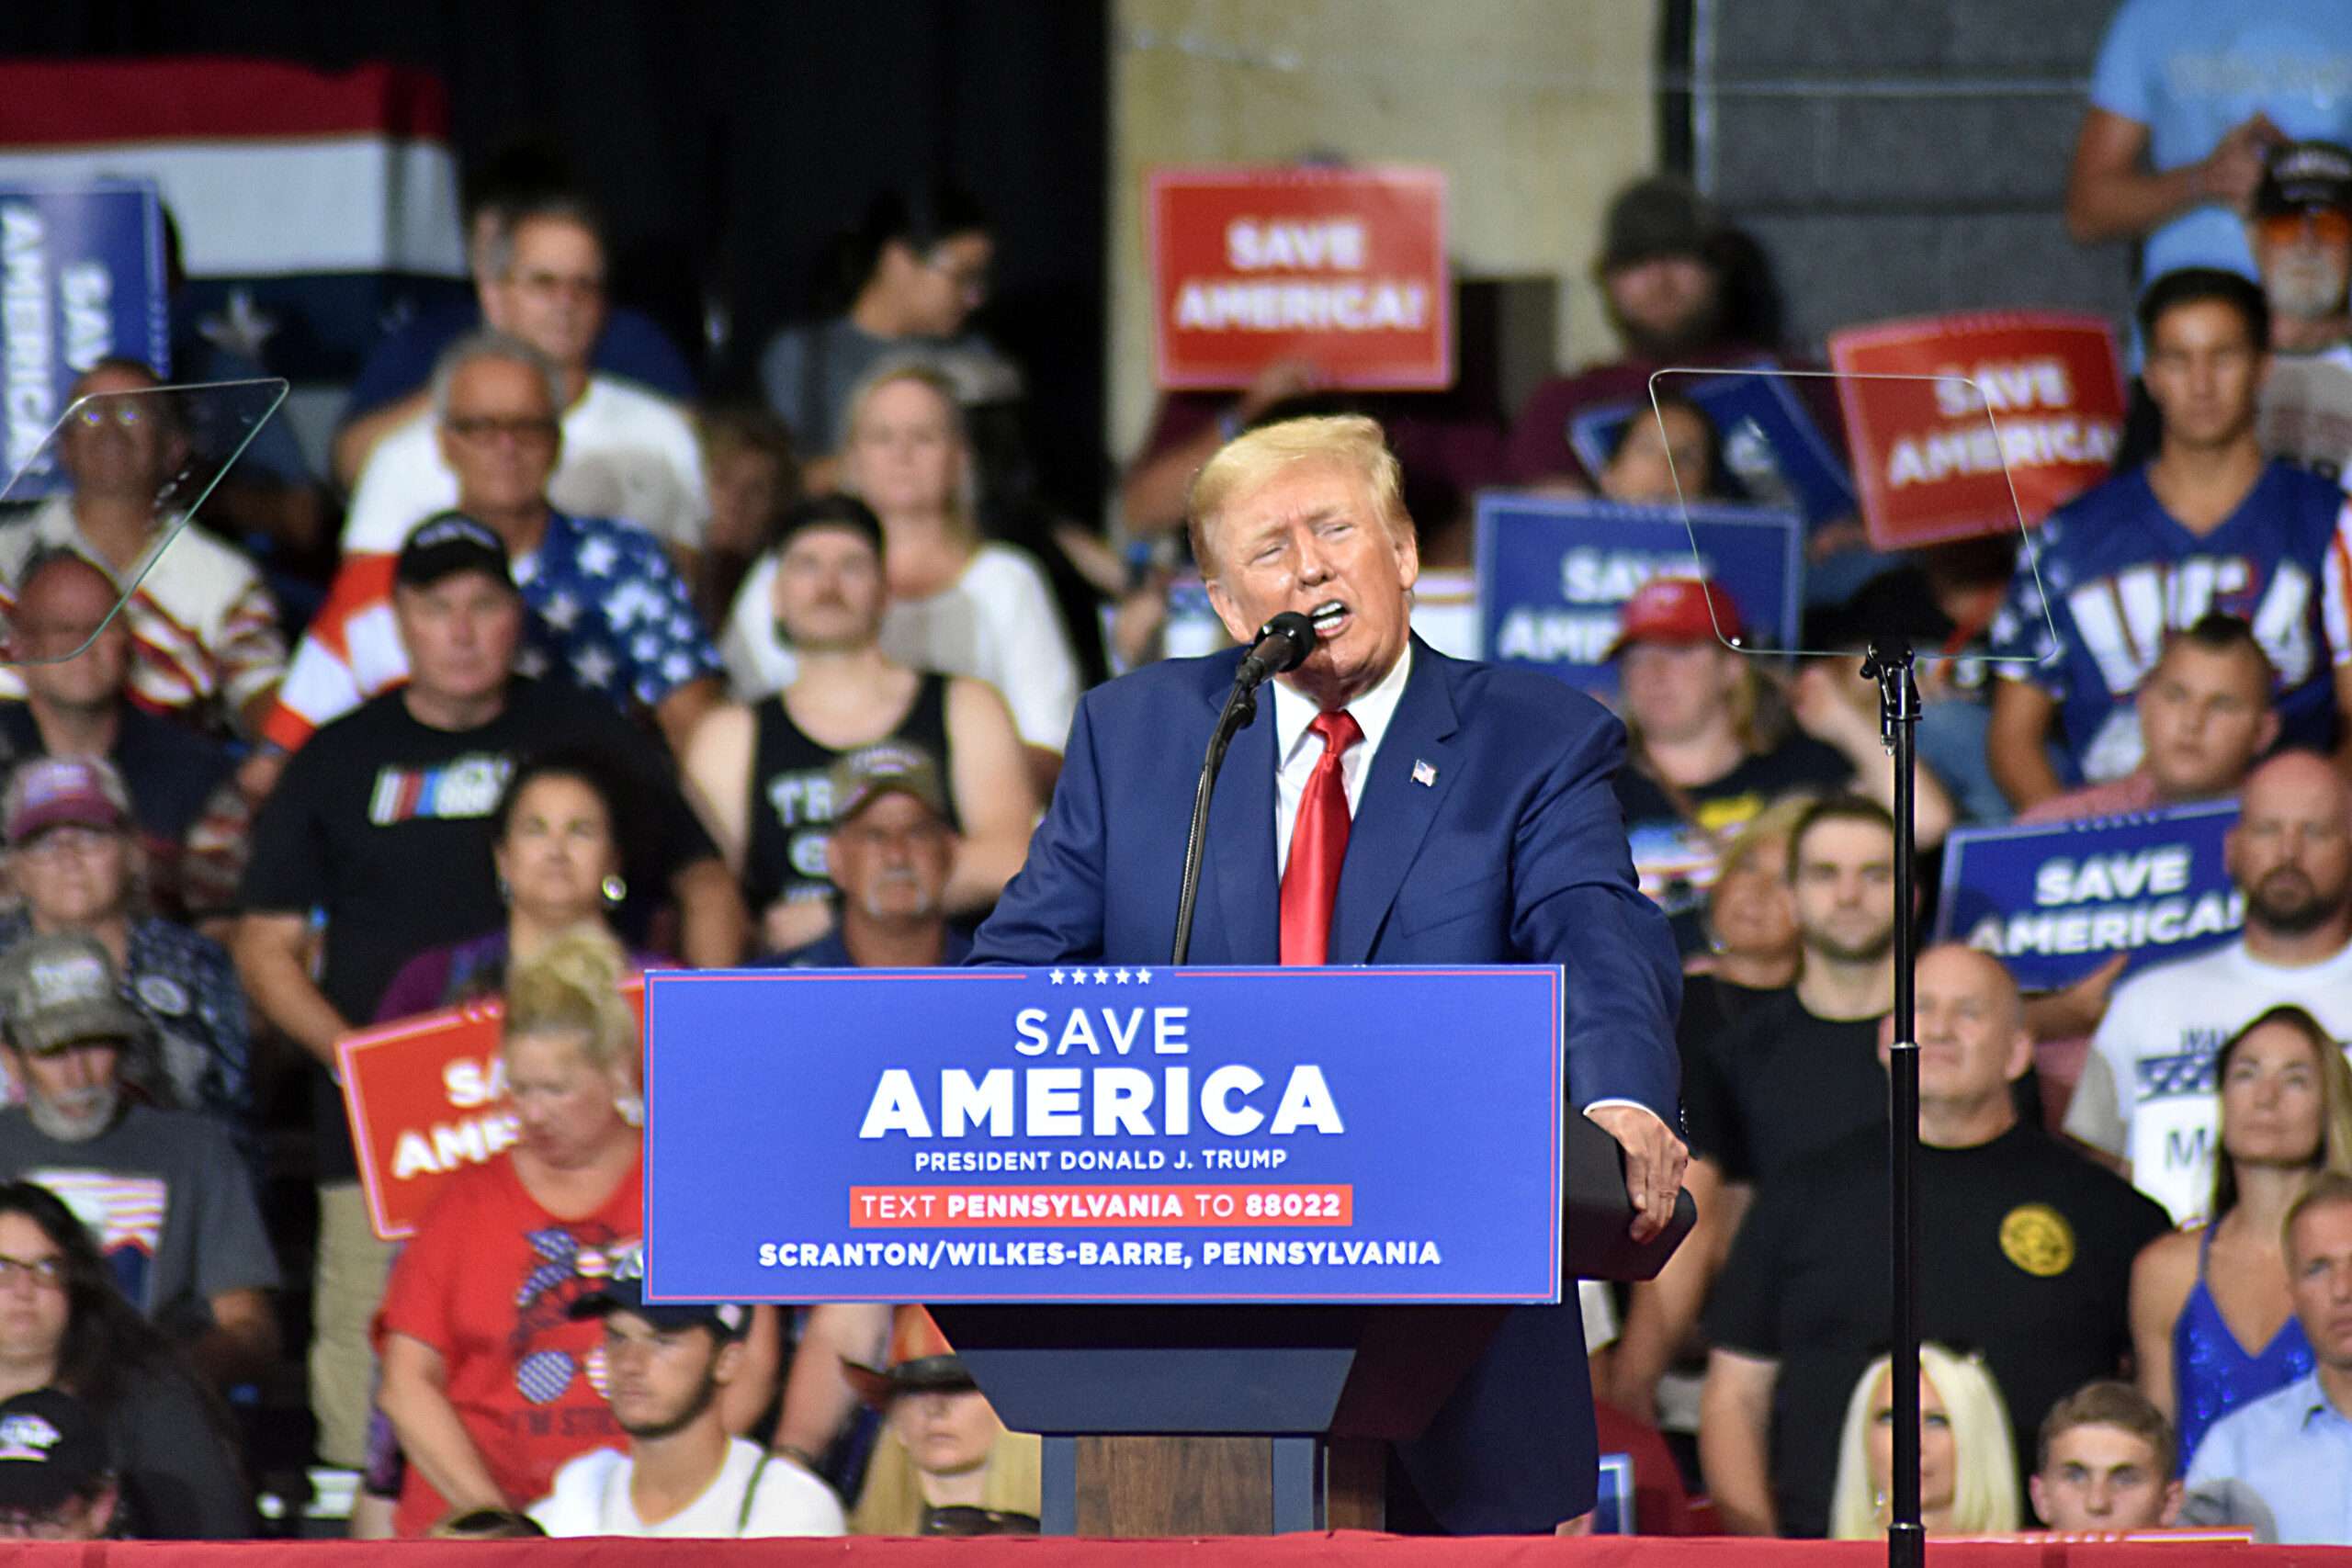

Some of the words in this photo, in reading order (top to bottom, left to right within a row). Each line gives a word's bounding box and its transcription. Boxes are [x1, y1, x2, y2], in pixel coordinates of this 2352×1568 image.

[1227, 217, 1364, 271] SAVE
[1176, 284, 1426, 332] AMERICA!
[1933, 358, 2067, 415] SAVE
[2033, 847, 2190, 906] SAVE
[1970, 891, 2246, 953] AMERICA!
[1014, 1007, 1189, 1055] SAVE
[859, 1065, 1344, 1138] AMERICA
[915, 1151, 1052, 1171] PRESIDENT
[1060, 1150, 1165, 1170] DONALD
[1173, 1150, 1193, 1169] J.
[1202, 1149, 1287, 1169] TRUMP
[860, 1195, 937, 1219] TEXT
[947, 1194, 1184, 1218] PENNSYLVANIA
[1194, 1193, 1235, 1217] TO
[1245, 1193, 1340, 1217] 88022
[759, 1240, 1193, 1269] SCRANTON/WILKES-BARRE,
[1204, 1241, 1441, 1265] PENNSYLVANIA
